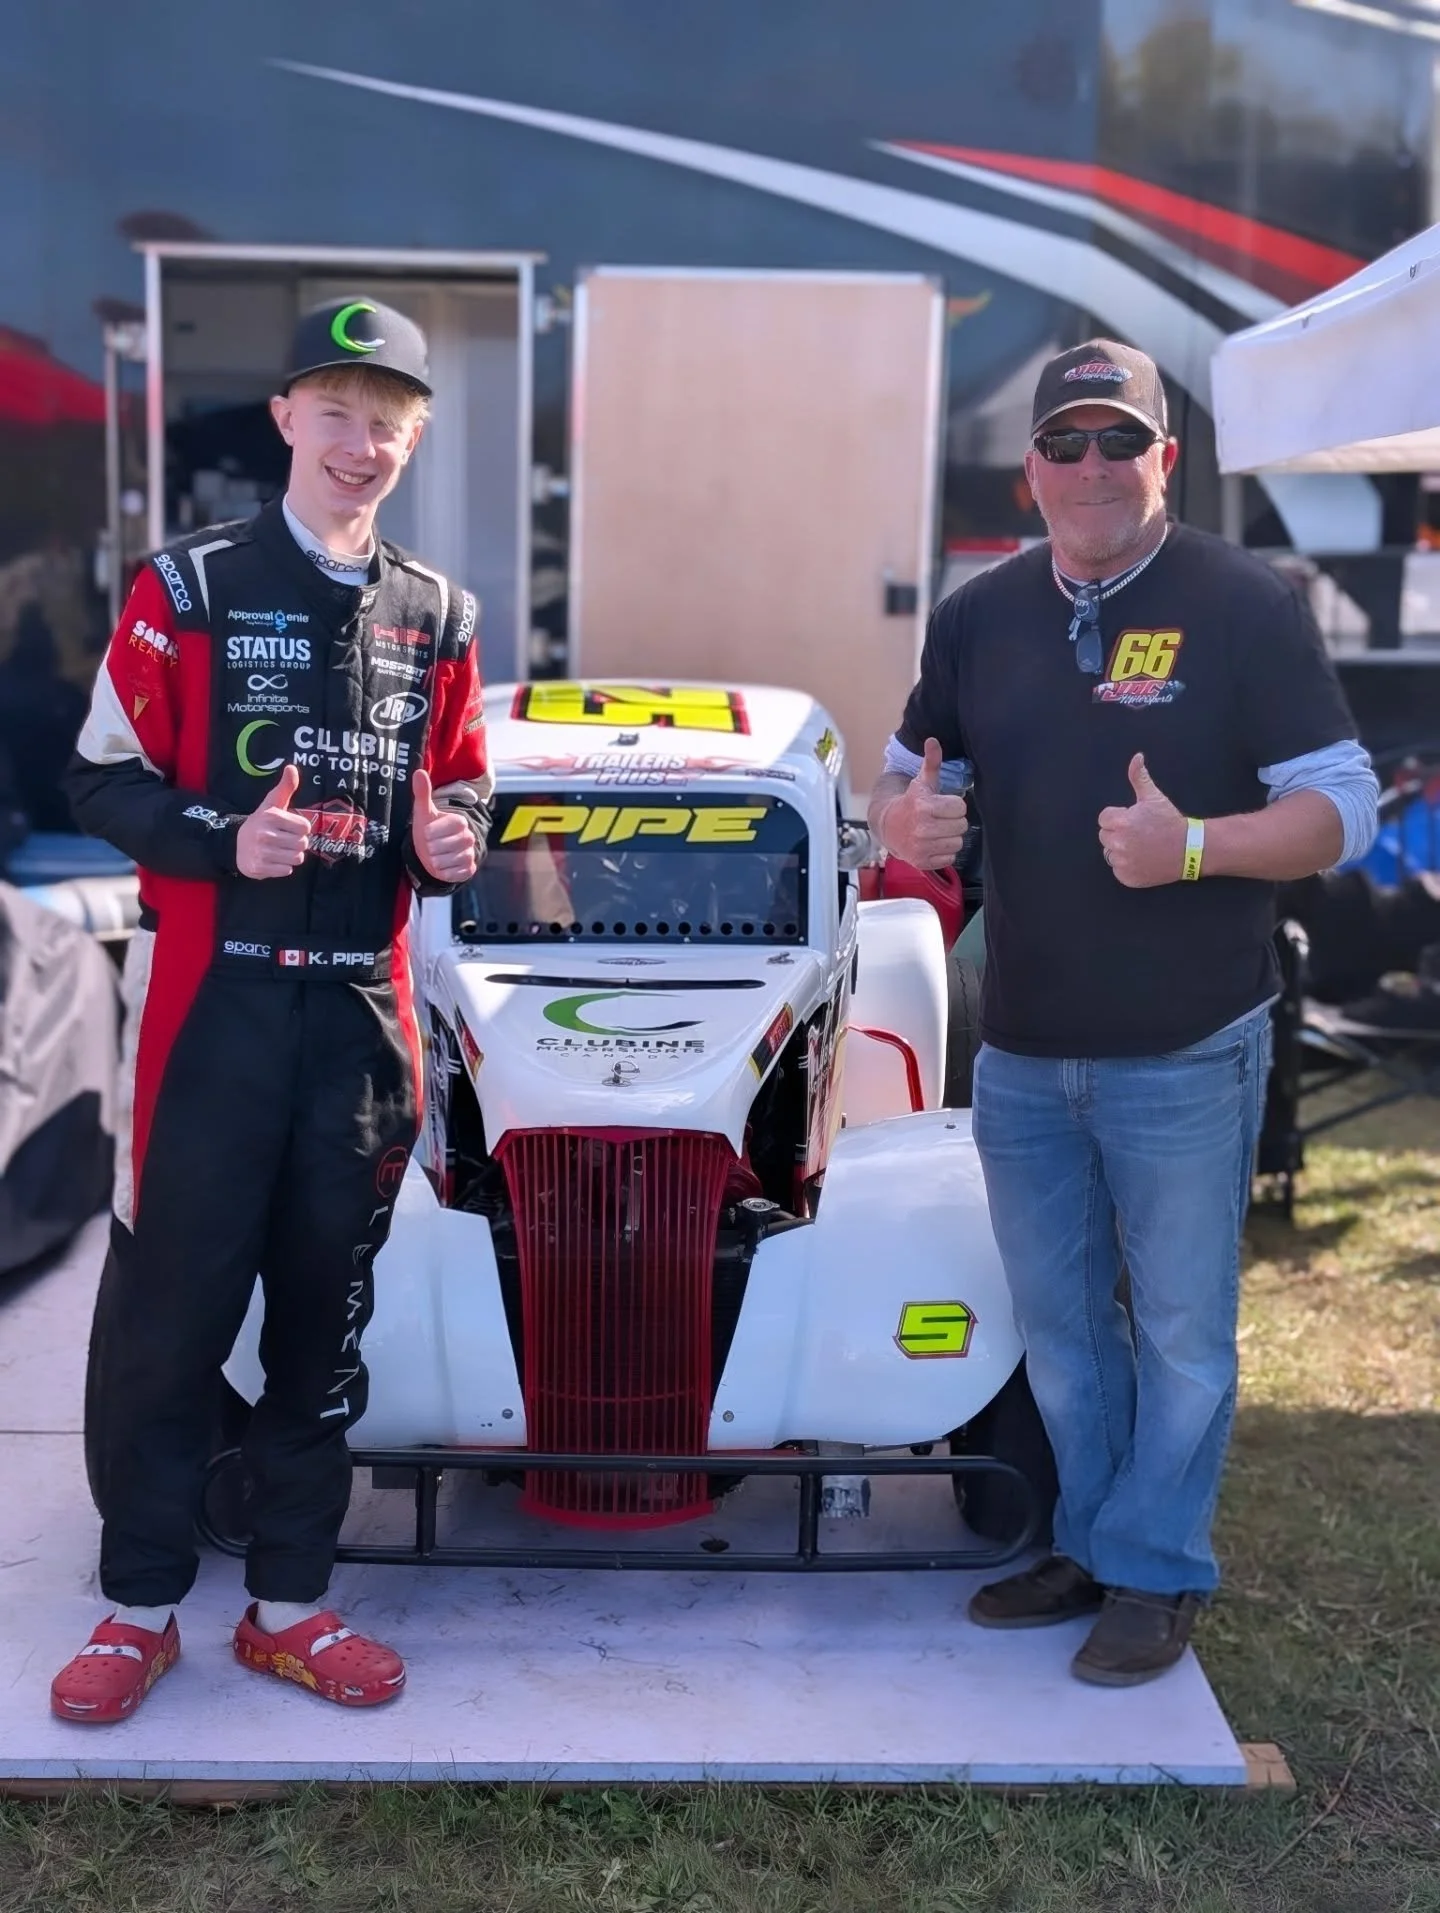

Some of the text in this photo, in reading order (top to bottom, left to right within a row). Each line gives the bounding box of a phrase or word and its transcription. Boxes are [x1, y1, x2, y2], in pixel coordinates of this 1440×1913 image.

[153, 553, 192, 614] sparco
[128, 634, 178, 668] REALTY
[226, 636, 311, 661] STATUS
[375, 640, 429, 659] MOTORSPORTS
[1108, 629, 1182, 682] 66
[227, 661, 311, 670] LOGISTICS GROUP
[370, 656, 427, 678] MOSPORT
[227, 703, 311, 714] Motorsports
[247, 693, 289, 703] Infinite
[379, 697, 416, 722] JRP
[293, 752, 407, 782] MOTOSPOS
[573, 753, 688, 769] TRAILERS
[499, 806, 768, 844] PIPE
[308, 952, 375, 966] K. PIPE
[536, 1038, 705, 1048] CLUBINE
[536, 1046, 704, 1054] MOTORSPORTS
[896, 1301, 974, 1358] 5
